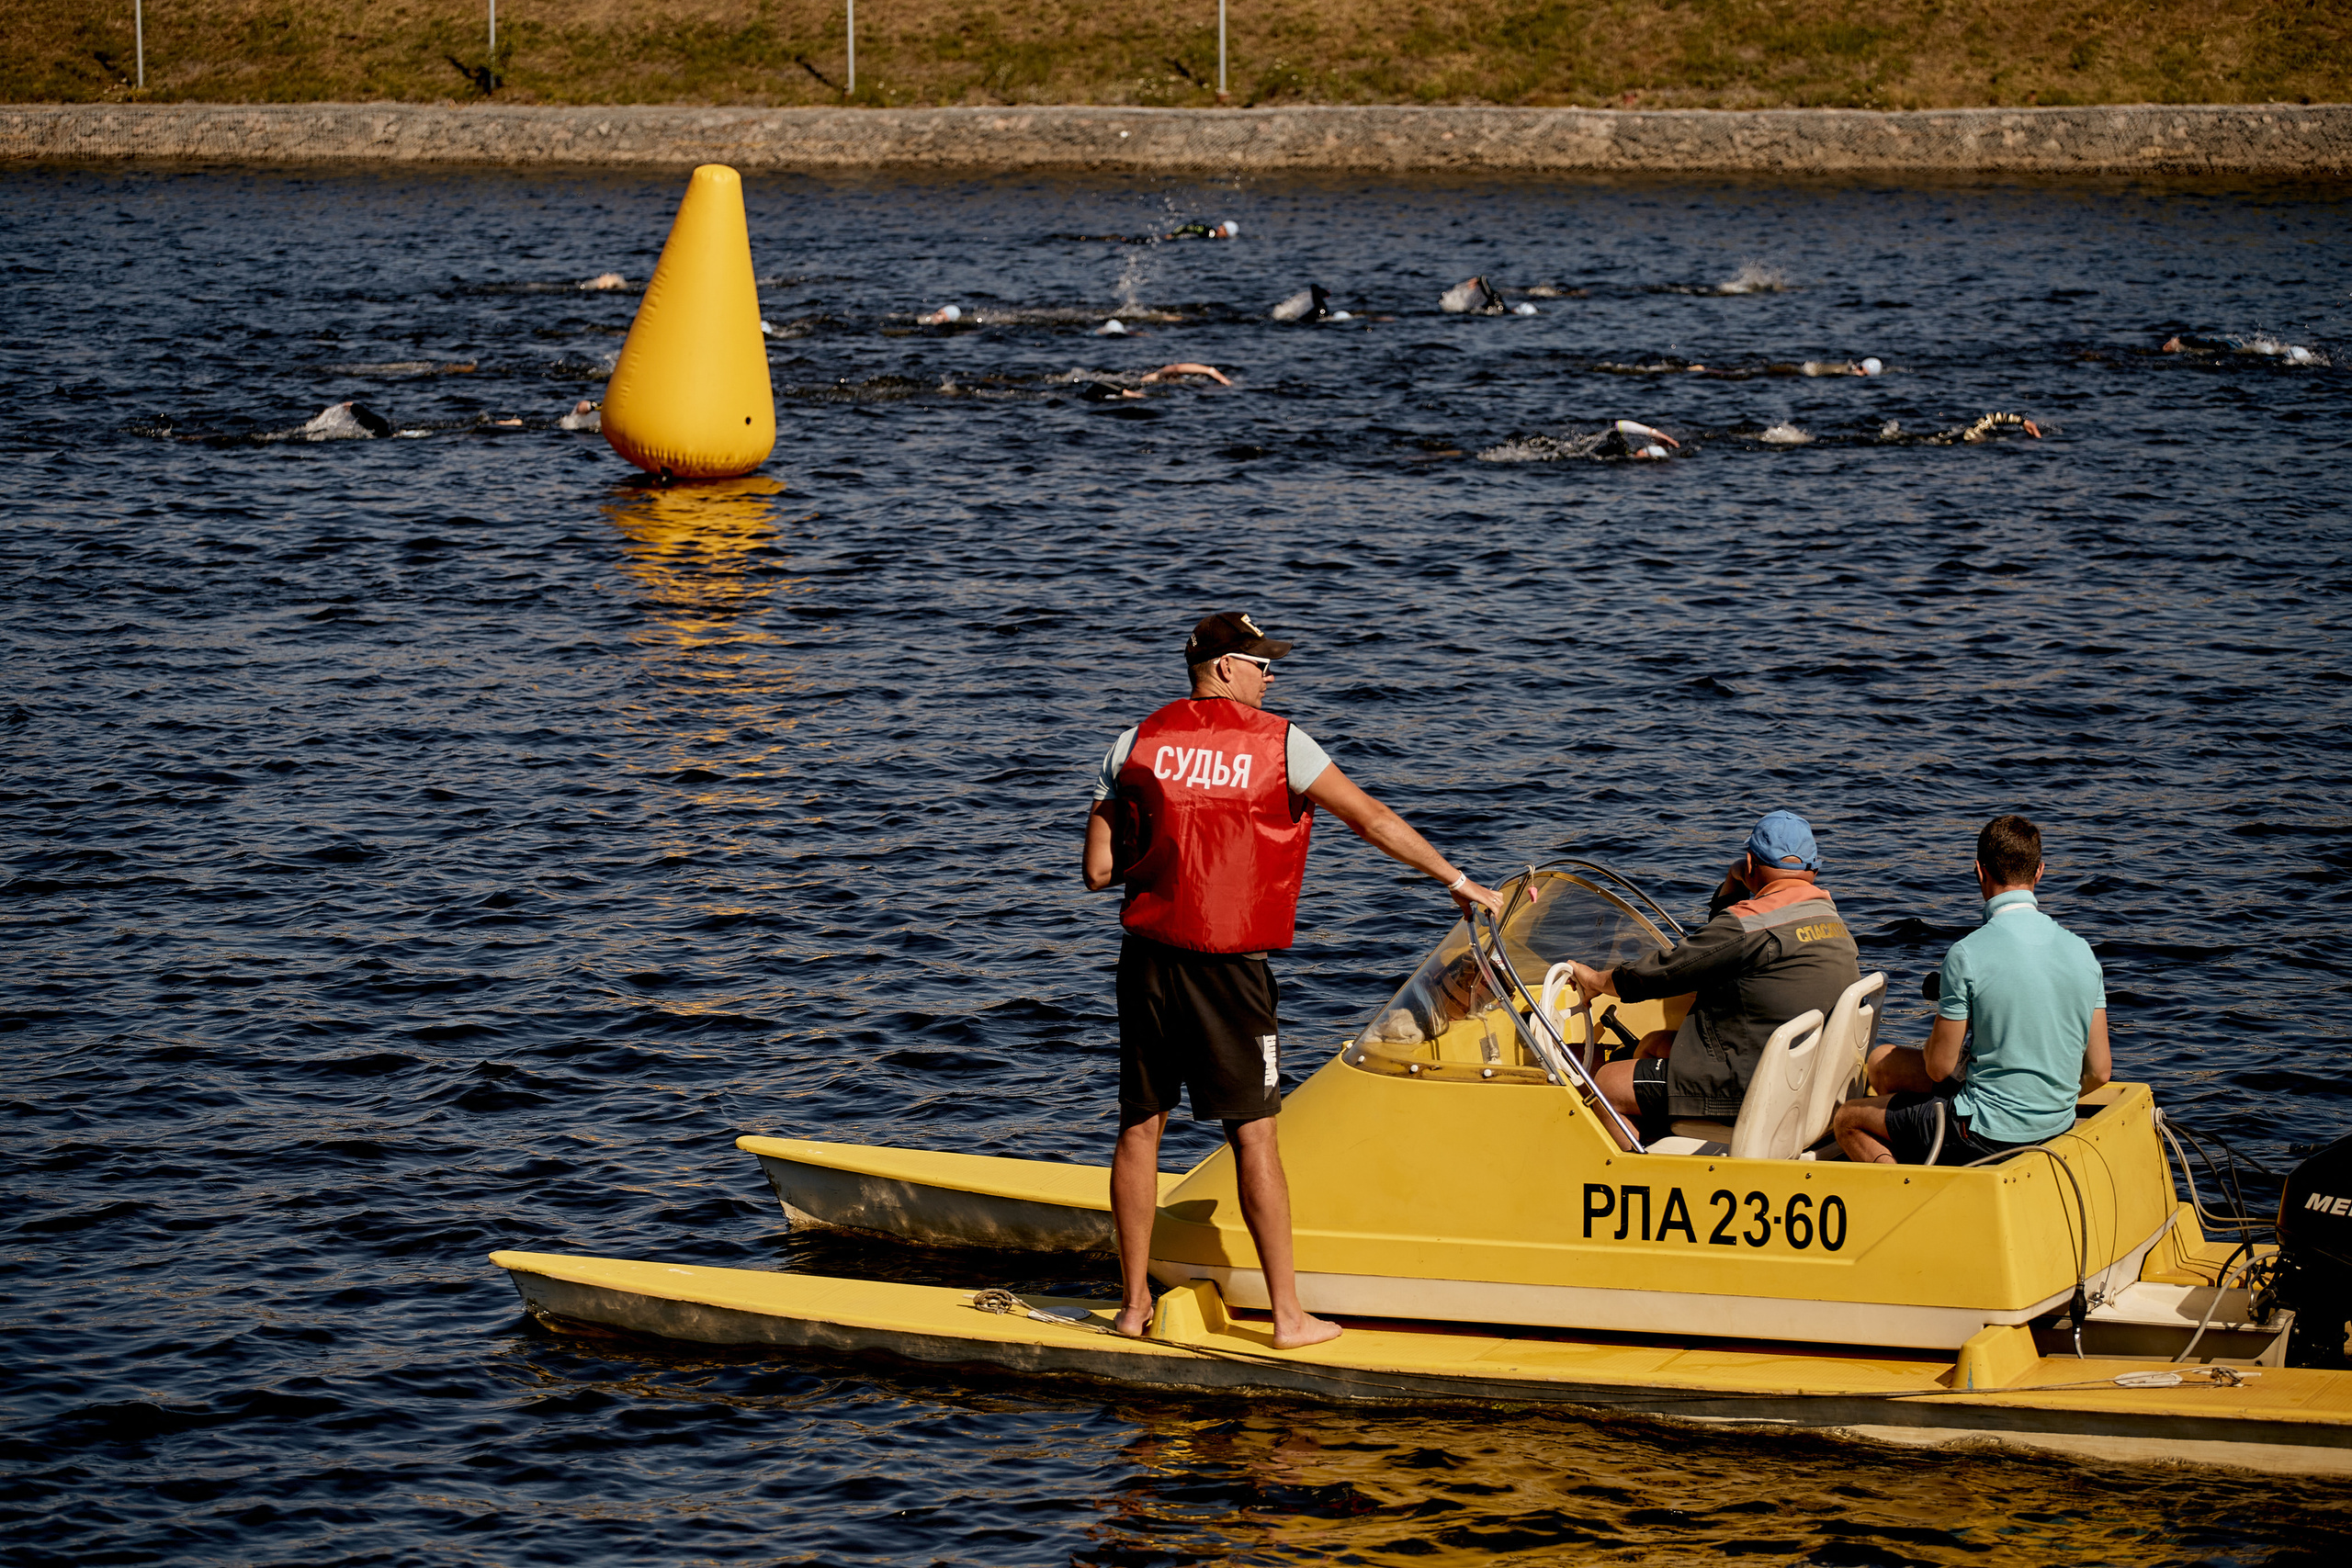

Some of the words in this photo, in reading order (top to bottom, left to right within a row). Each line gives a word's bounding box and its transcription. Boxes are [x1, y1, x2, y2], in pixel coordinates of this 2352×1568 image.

[1154, 745, 1252, 790] СУДЬЯ
[1582, 1182, 1698, 1244] РЛА
[2304, 1192, 2352, 1217] ME
